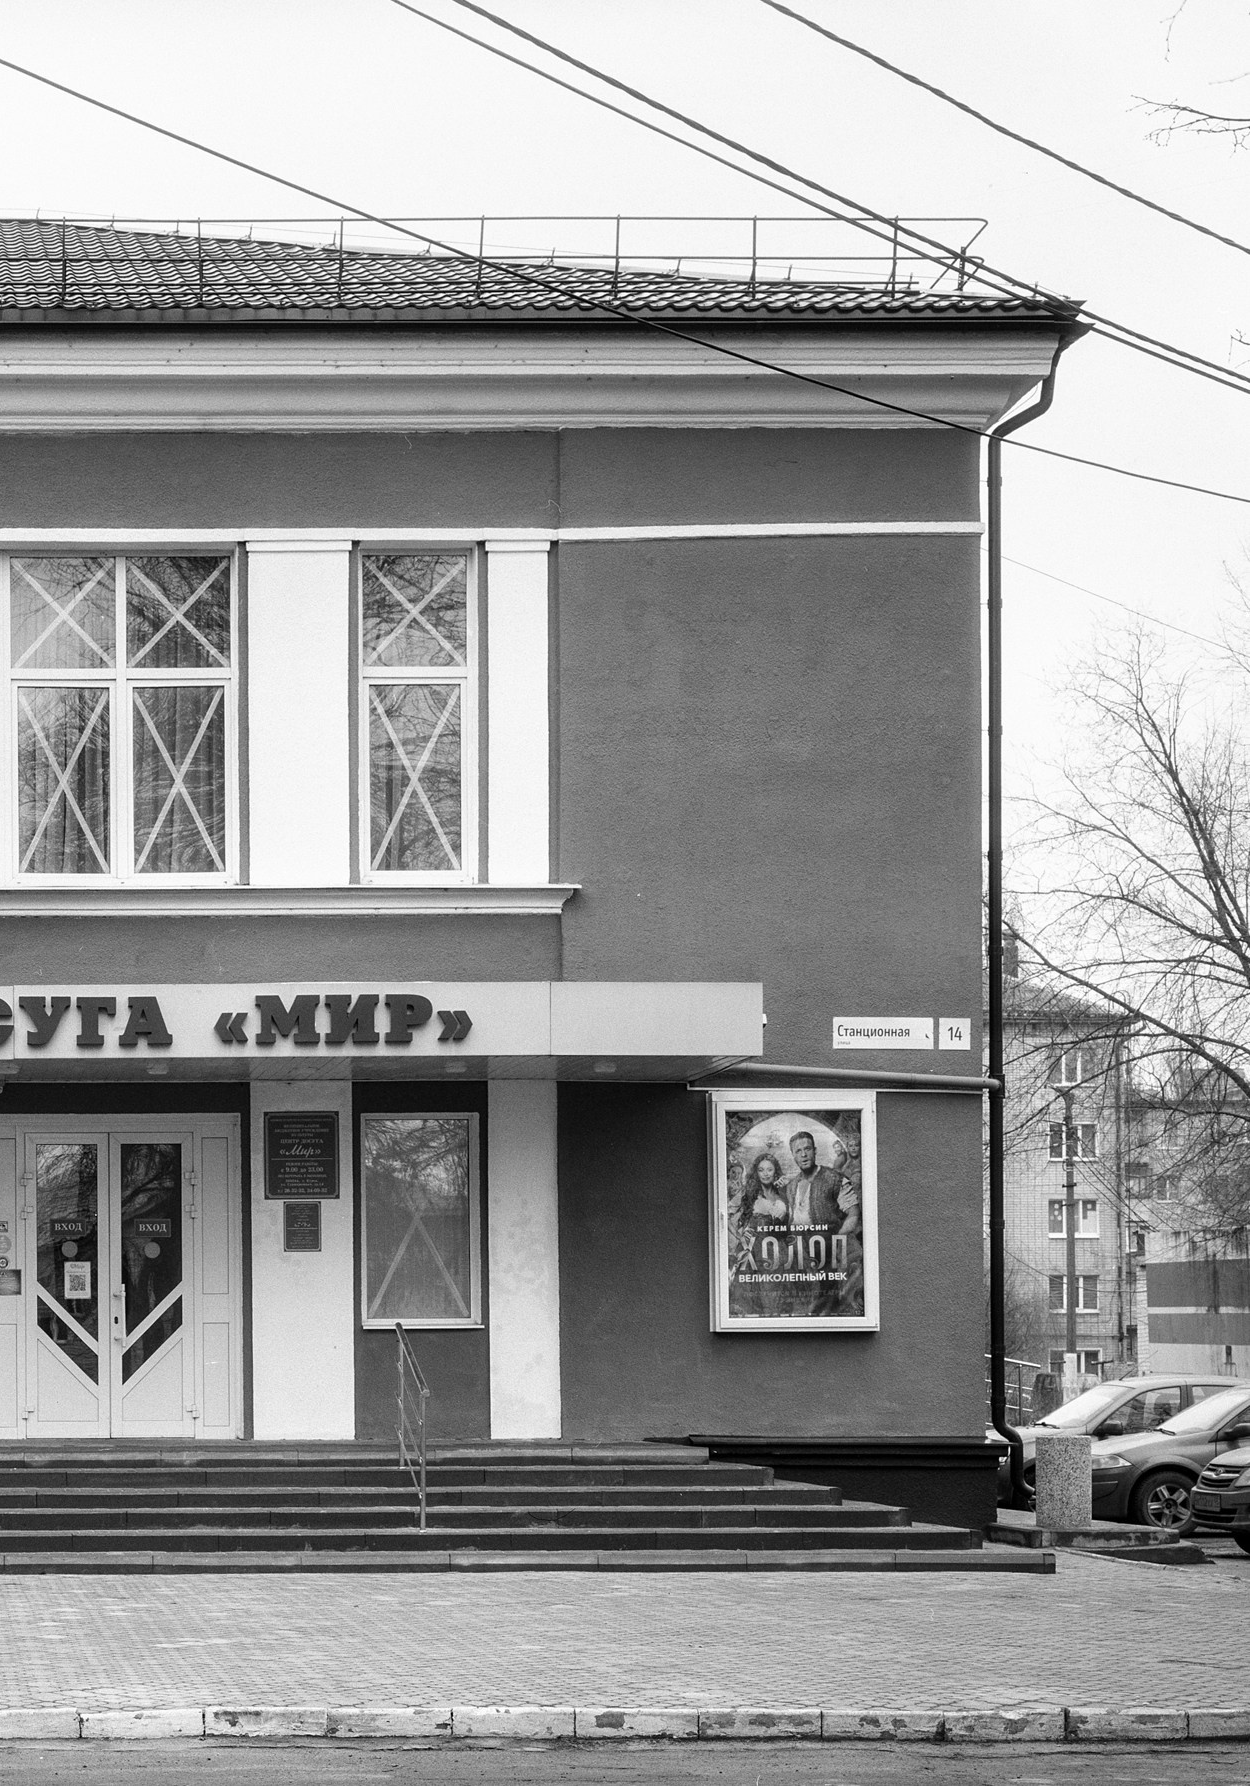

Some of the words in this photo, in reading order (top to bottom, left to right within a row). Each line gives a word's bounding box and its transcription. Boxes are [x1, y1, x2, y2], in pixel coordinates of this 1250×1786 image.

[213, 993, 473, 1045] «МИР»
[837, 1024, 910, 1038] Станционная
[947, 1026, 963, 1042] 14
[279, 1144, 321, 1158] «Мир»
[54, 1223, 83, 1232] ВХОД
[139, 1223, 167, 1233] ВХОД
[740, 1234, 847, 1271] ХОЛОП
[739, 1271, 826, 1283] ВЕЛИКОЛЕПНЫЙ
[828, 1272, 848, 1281] ВЕК
